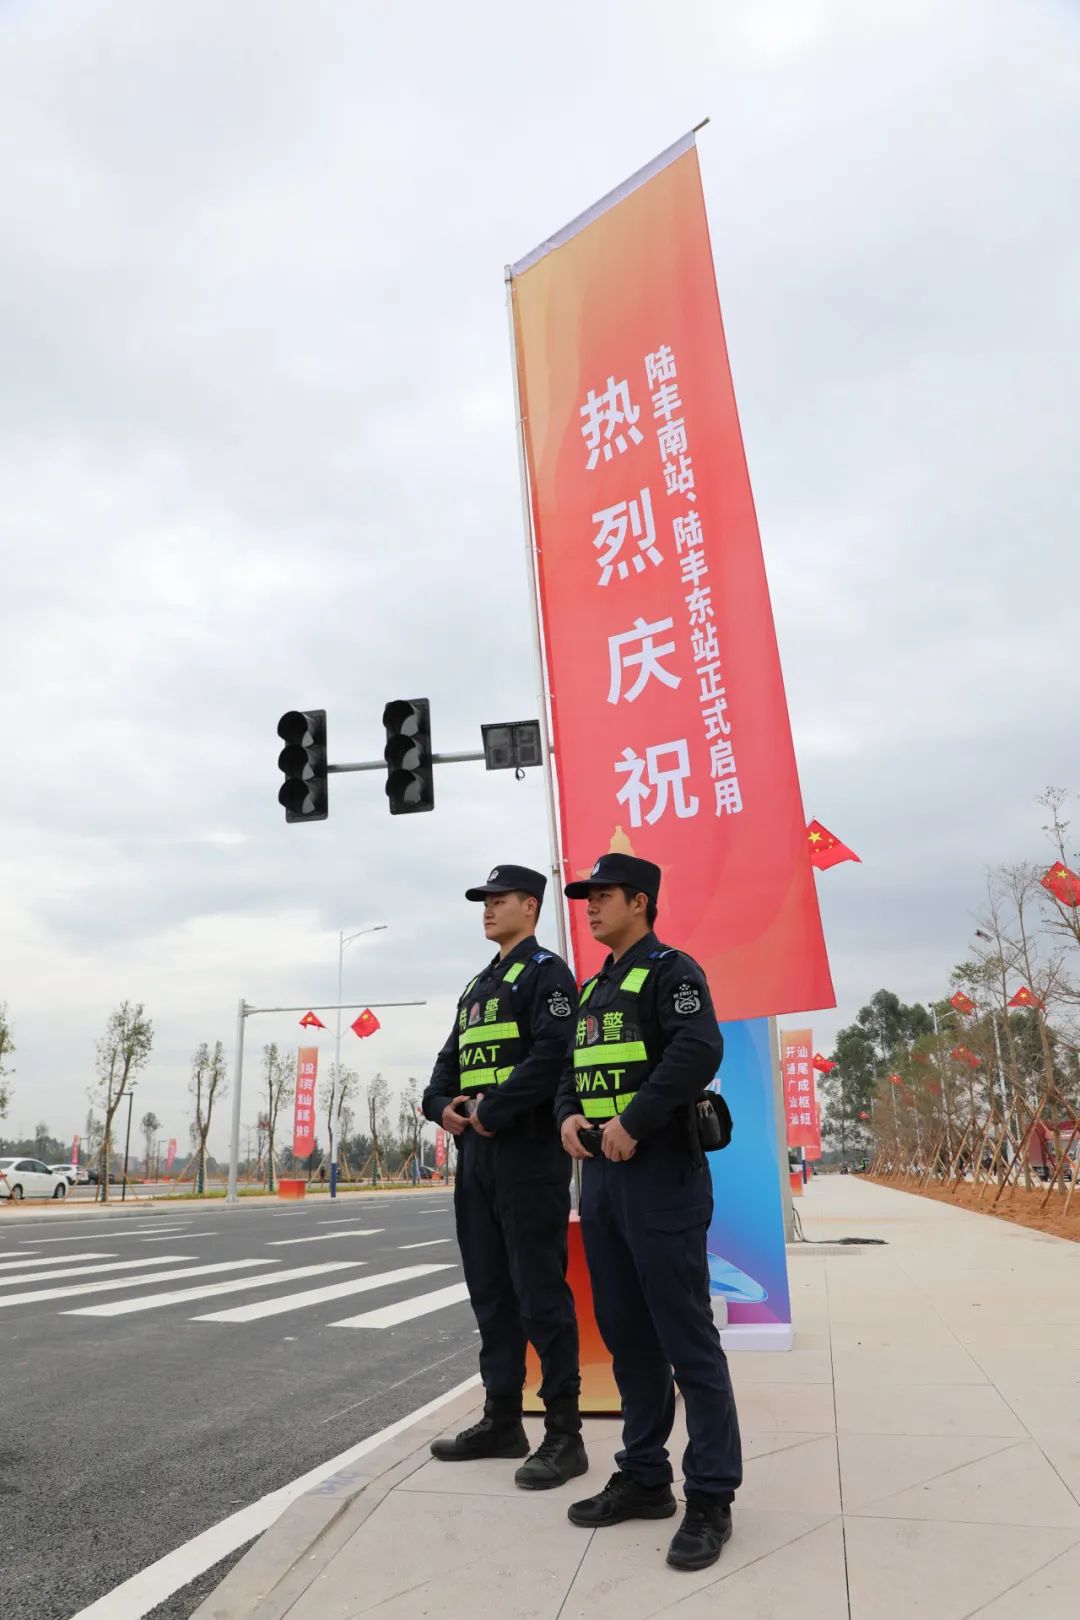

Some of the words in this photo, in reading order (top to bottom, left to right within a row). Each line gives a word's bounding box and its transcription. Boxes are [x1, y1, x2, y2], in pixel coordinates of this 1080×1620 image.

[579, 375, 700, 829] 热烈庆祝
[645, 344, 744, 818] 陆丰南站、陆丰东站正式启用
